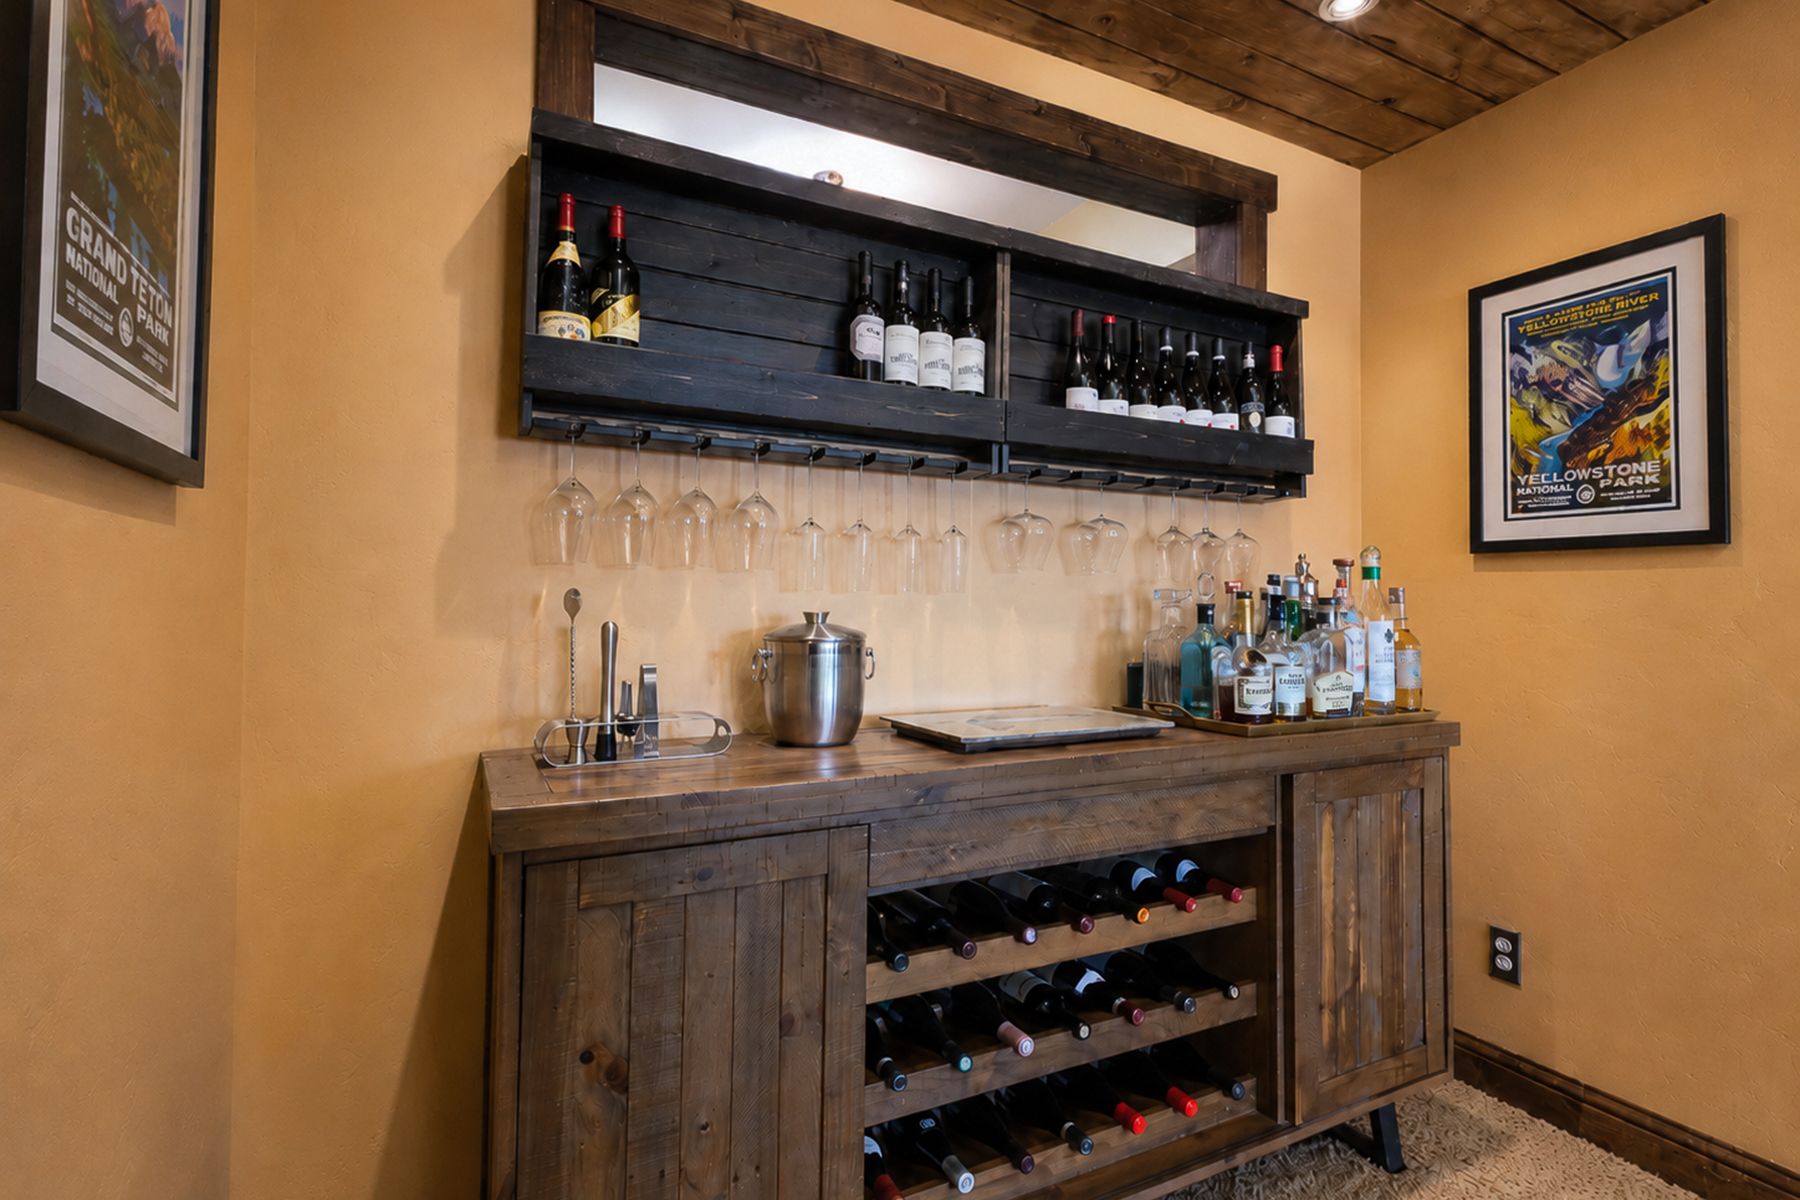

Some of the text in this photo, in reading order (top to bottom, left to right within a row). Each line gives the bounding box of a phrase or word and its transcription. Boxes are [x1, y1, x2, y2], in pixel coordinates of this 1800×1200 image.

[66, 207, 127, 285] GRAND
[130, 265, 172, 328] TETON
[65, 242, 119, 305] NATIONAL
[137, 303, 169, 346] PARK
[1518, 304, 1612, 334] YELLOWSTONE
[1615, 292, 1660, 310] RIVER
[1516, 460, 1661, 486] YELLOWSTONE
[1516, 473, 1660, 496] NATIONAL PARK
